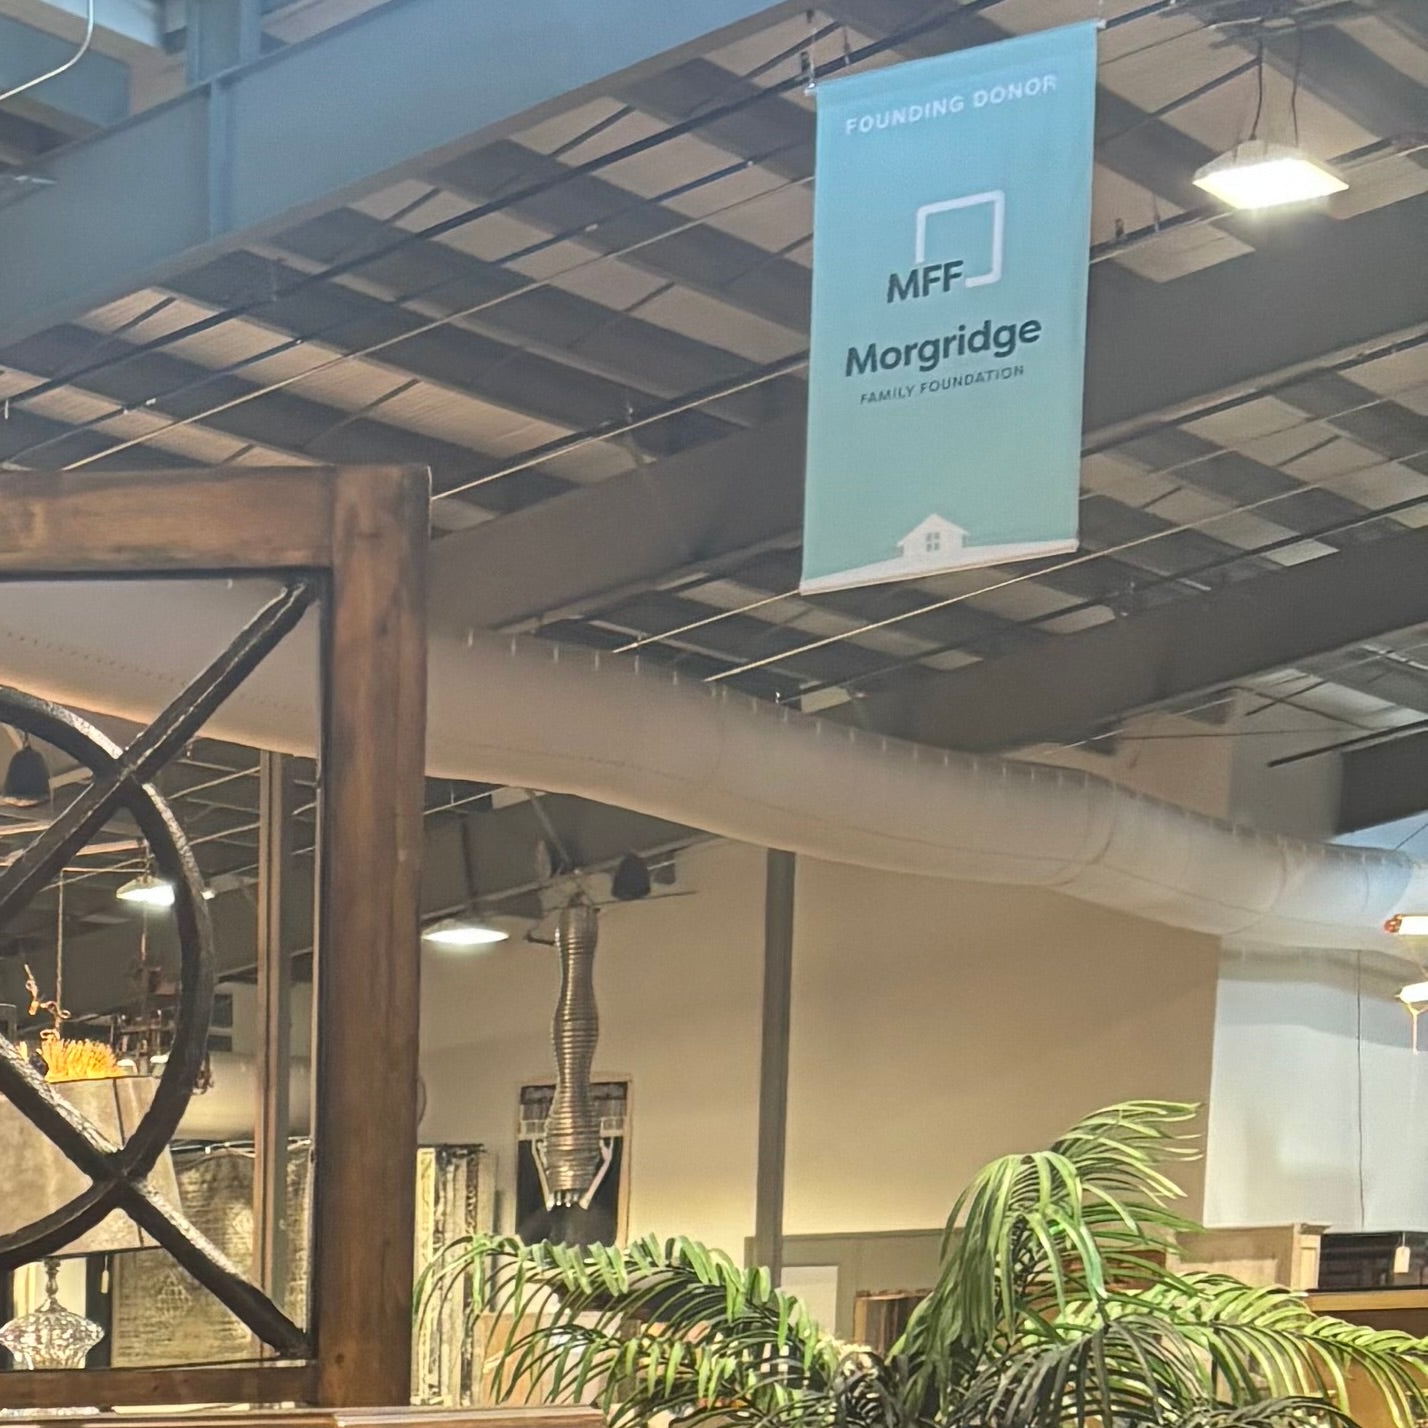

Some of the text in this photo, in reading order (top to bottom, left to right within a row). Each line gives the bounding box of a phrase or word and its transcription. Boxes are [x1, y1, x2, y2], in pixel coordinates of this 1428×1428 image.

[845, 74, 1057, 135] FOUNDING DONOR
[887, 259, 964, 303] MFF
[845, 319, 1042, 377] Morgridge
[860, 365, 1024, 405] FAMILY FOUNDATION
